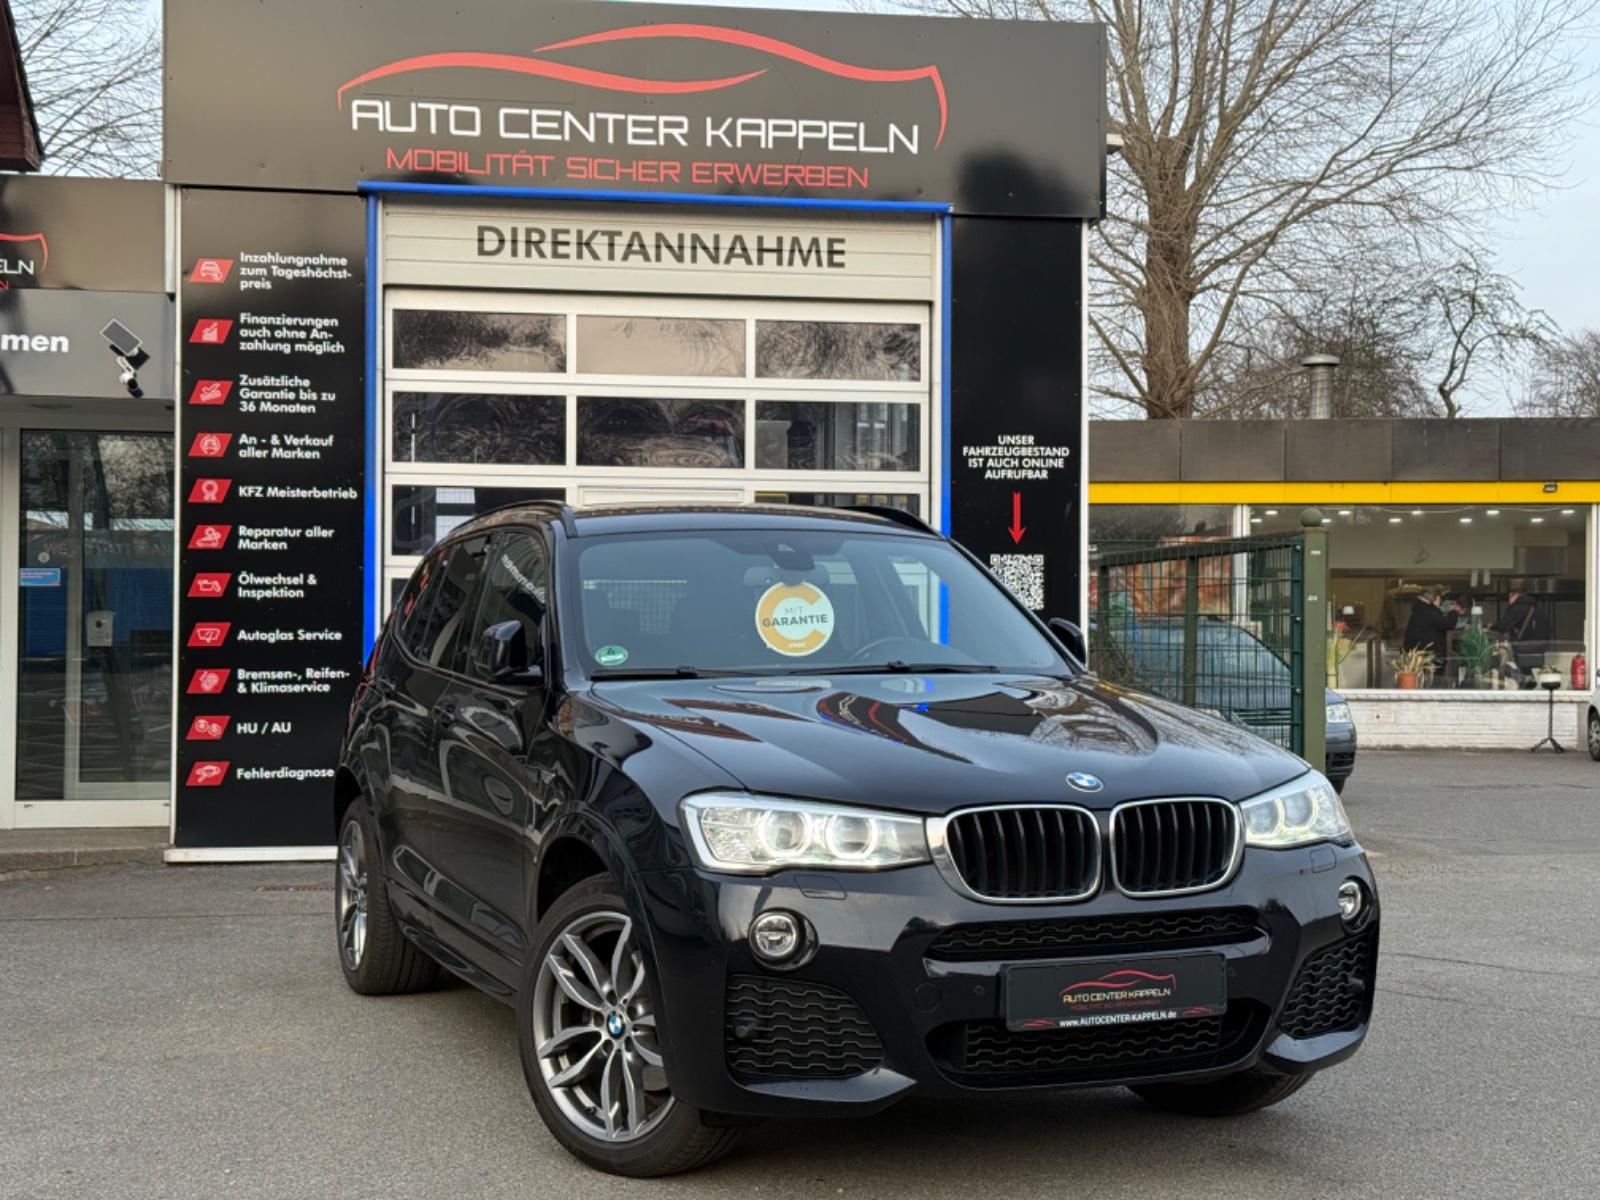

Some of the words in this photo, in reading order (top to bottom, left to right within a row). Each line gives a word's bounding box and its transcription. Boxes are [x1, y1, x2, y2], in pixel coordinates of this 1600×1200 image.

[351, 99, 481, 137] AUTO
[499, 109, 689, 147] CENTER
[705, 117, 919, 155] KAPPELN
[386, 148, 555, 177] MOBILITÄT
[565, 156, 681, 184] SICHER
[690, 162, 870, 190] ERWERBEN
[475, 223, 847, 270] DIREKTANNAHME
[240, 252, 348, 268] Inzahlungnahme
[240, 267, 268, 276] zum
[272, 266, 352, 279] Tageshöchst-
[240, 279, 272, 291] preis
[240, 313, 338, 329] Finanzierungen
[240, 327, 271, 338] auch
[275, 328, 307, 339] ohne
[310, 328, 334, 339] An-
[240, 340, 291, 354] zahlung
[295, 342, 345, 354] möglich
[240, 375, 310, 387] Zusätzliche
[240, 389, 296, 400] Garantie
[300, 389, 317, 400] bis
[321, 392, 336, 401] zu
[240, 401, 256, 412] 36
[260, 401, 316, 413] Monaten
[271, 435, 280, 445] &
[284, 435, 334, 447] Verkauf
[998, 435, 1035, 445] UNSER
[239, 447, 268, 458] aller
[271, 448, 320, 459] Marken
[962, 447, 1070, 456] FAHRZEUGBESTAND
[968, 459, 984, 468] IST
[986, 459, 1019, 468] AUCH
[1022, 459, 1064, 468] ONLINE
[984, 470, 1048, 479] AUFRUFBAR
[239, 486, 263, 497] KFZ
[266, 487, 357, 499] Meisterbetrieb
[238, 525, 302, 539] Reparatur
[305, 527, 334, 538] aller
[238, 539, 287, 550] Marken
[238, 571, 304, 585] Ölwechsel
[308, 575, 317, 585] &
[238, 587, 304, 600] Inspektion
[762, 614, 828, 627] GARANTIE
[238, 630, 294, 642] Autoglas
[298, 631, 342, 640] Service
[305, 669, 350, 679] Reifen-
[238, 683, 246, 693] &
[251, 682, 330, 692] Klimaservice
[237, 723, 257, 733] HU
[261, 723, 268, 733] /
[271, 722, 291, 732] AU
[237, 768, 335, 780] Fehlerdiagnose
[1063, 993, 1089, 1004] AUTO
[1090, 990, 1128, 1002] CENTER
[1129, 988, 1171, 999] KAPPELN
[1060, 1011, 1177, 1027] www.AUTOCENTER-KAPPELN.de
